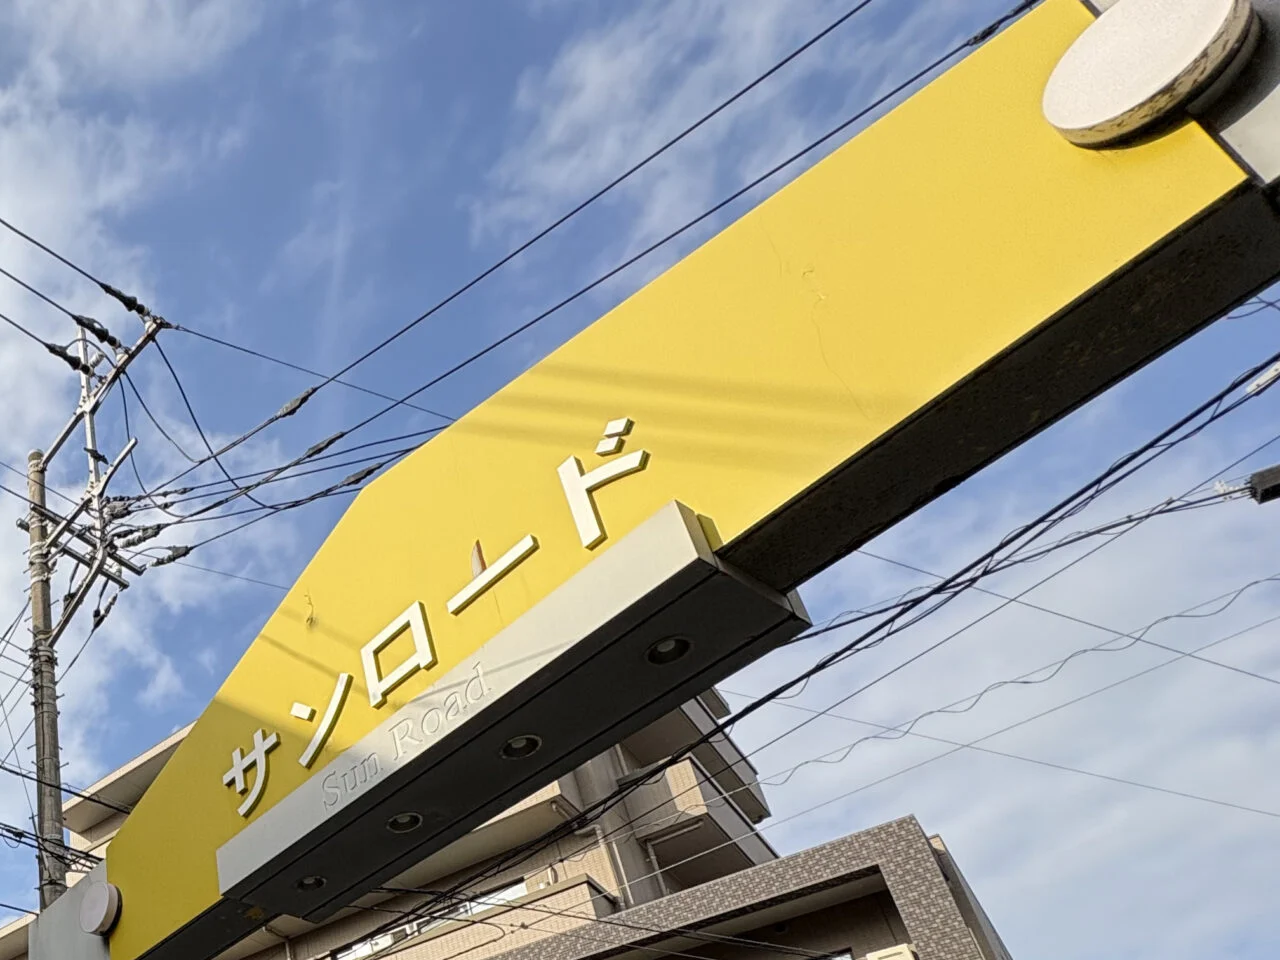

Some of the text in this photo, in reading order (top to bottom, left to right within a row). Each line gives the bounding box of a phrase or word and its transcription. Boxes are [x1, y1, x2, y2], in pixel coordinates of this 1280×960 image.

[222, 417, 651, 818] サンロード
[322, 661, 492, 812] Sun Road
